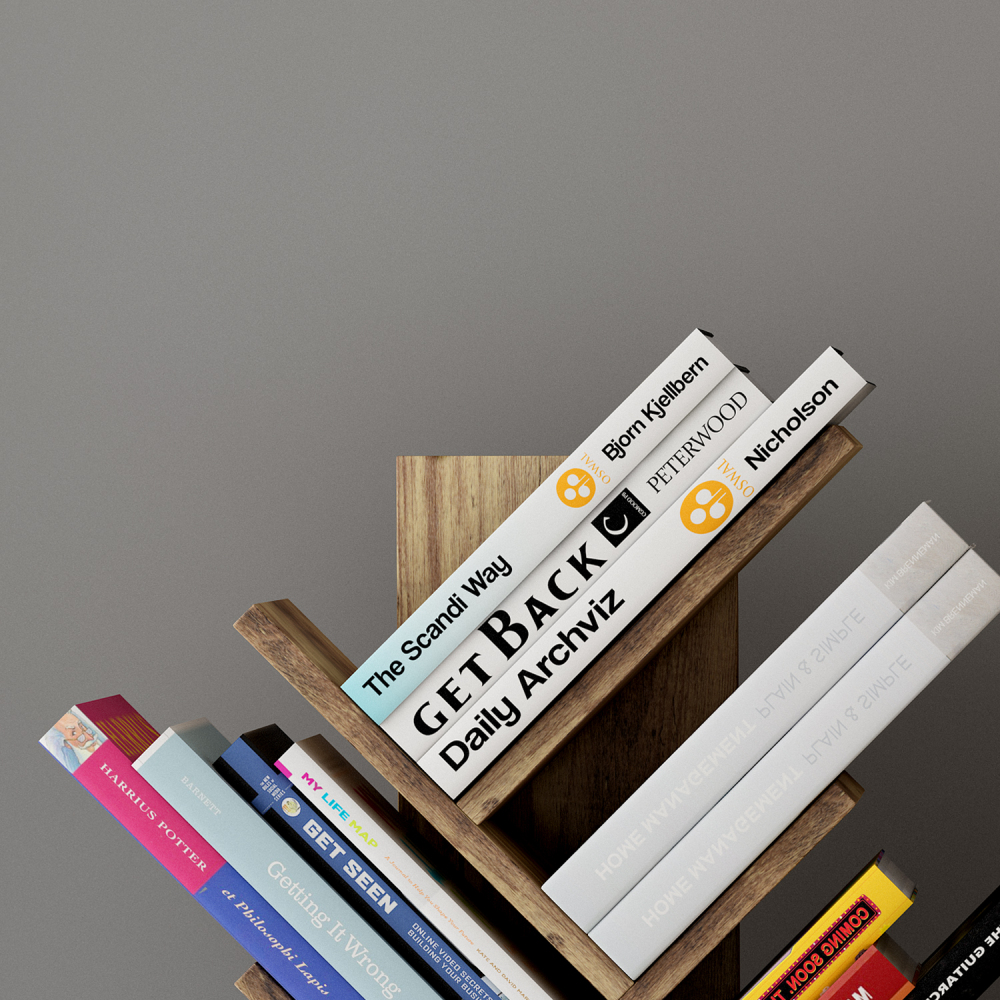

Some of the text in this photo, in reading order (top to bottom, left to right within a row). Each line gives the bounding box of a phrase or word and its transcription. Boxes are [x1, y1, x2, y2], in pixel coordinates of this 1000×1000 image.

[601, 356, 710, 462] Bjorn Kjellbern
[646, 391, 748, 494] PETERWOOD
[744, 379, 839, 471] Nicholson
[580, 453, 611, 485] OSWAL
[717, 458, 755, 498] OSWAL
[361, 554, 513, 696] The Scandi Way
[413, 541, 608, 736] GET BACK
[438, 588, 626, 772] Daily Archviz
[99, 763, 207, 872] HARRIUS POTTER
[180, 775, 222, 816] BARNETT
[301, 771, 379, 848] MY LIFE MAP
[302, 818, 398, 915] GET SEEN
[221, 889, 330, 995] et Philosophi Lapis
[267, 861, 402, 1000] Getting It Wrong
[407, 929, 442, 964] BUILDING
[441, 962, 462, 984] YOUR
[412, 922, 440, 950] ONLINE
[438, 948, 461, 972] VIDEO
[476, 947, 491, 963] KATE
[489, 962, 502, 974] AND
[501, 973, 517, 989] DAVID
